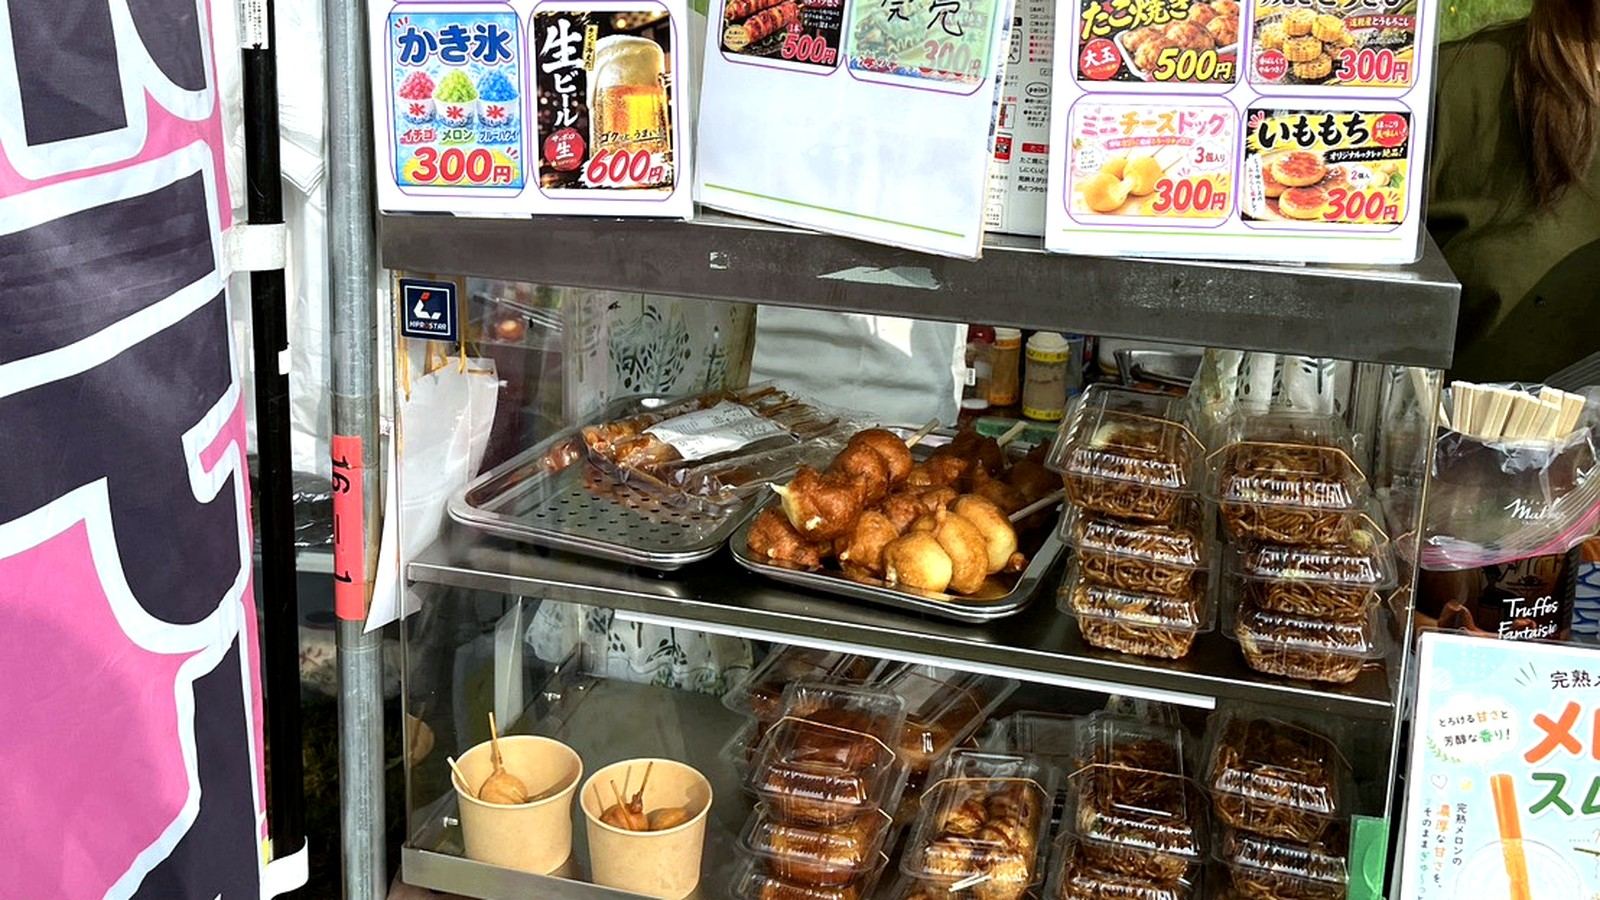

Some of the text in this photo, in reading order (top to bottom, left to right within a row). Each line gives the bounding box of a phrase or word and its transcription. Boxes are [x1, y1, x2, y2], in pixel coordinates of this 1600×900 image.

[398, 24, 512, 63] かき氷
[781, 35, 837, 65] 500円
[924, 39, 983, 76] 300円
[1084, 46, 1117, 68] 大玉
[539, 18, 583, 127] 生ビール
[1152, 47, 1233, 82] 500円
[1336, 48, 1408, 82] 300円
[409, 103, 426, 116] 氷
[446, 105, 464, 119] 氷
[486, 105, 504, 119] 氷
[1081, 110, 1229, 136] ミニチーズドッグ
[403, 129, 433, 141] イチゴ
[442, 130, 474, 141] メロン
[1258, 113, 1370, 148] いももち
[411, 147, 511, 183] 300円
[555, 141, 576, 160] 生
[1194, 147, 1226, 164] 3個入り
[587, 149, 663, 183] 600円
[1152, 178, 1227, 213] 300円
[1322, 187, 1399, 220] 300円
[1502, 595, 1559, 618] Truffes
[1438, 710, 1508, 728] とろける甘さと
[1524, 700, 1600, 764] メ
[1444, 728, 1510, 747] 芳醇な香り!
[1452, 802, 1468, 866] 完熟メロンの
